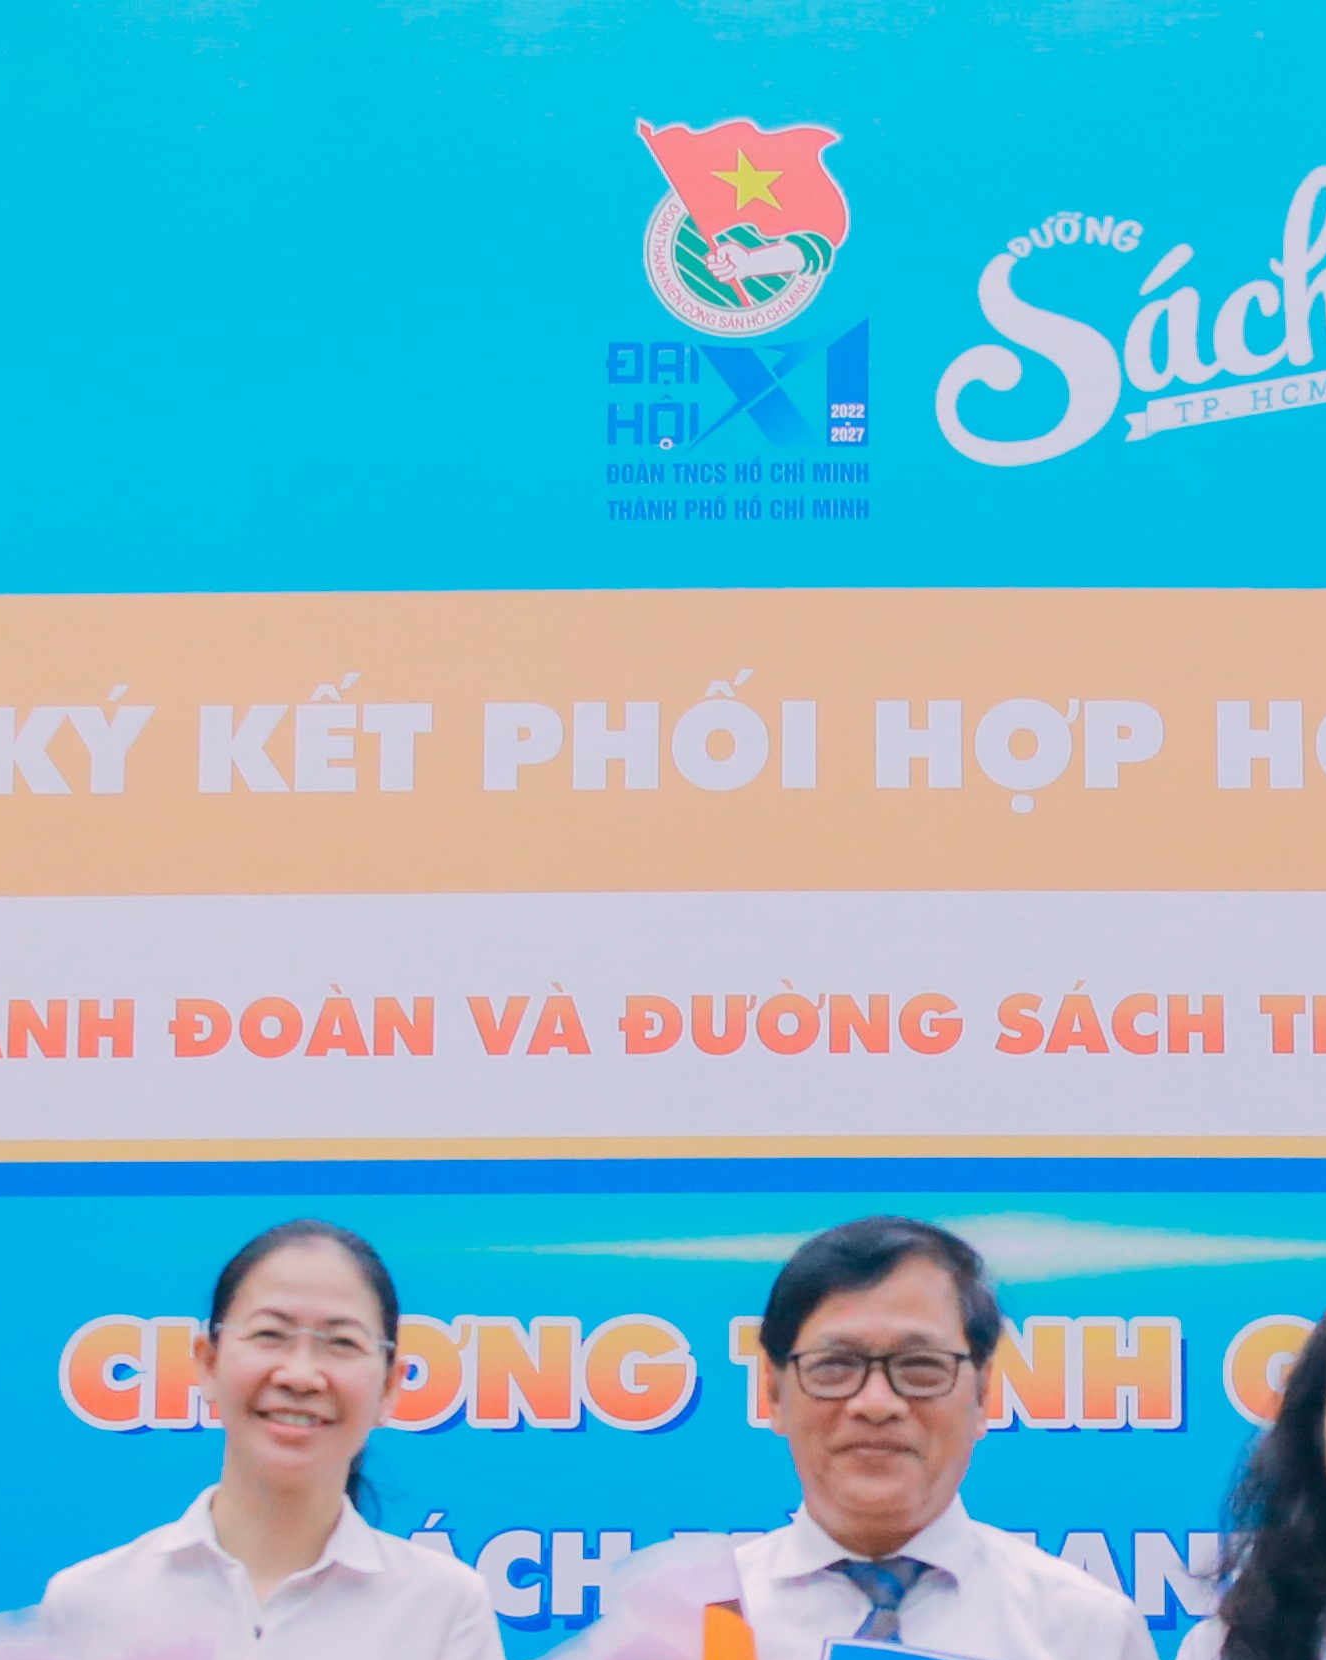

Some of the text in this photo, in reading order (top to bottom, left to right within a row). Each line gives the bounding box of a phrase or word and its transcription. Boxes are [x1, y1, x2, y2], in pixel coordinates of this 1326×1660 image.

[606, 342, 699, 386] ĐẠI
[607, 394, 699, 450] HỘI
[830, 403, 865, 419] 2022
[1175, 397, 1230, 424] TP.
[830, 427, 865, 443] 2027
[606, 455, 870, 484] ĐOÀN TNCS HỒ CHÍ MINH
[607, 492, 870, 521] THÀNH PHỐ HỒ CHÍ MINH
[198, 672, 433, 794] KẾT
[483, 669, 816, 792] PHỐI
[876, 697, 1165, 814] HỢP
[168, 984, 434, 1059] ĐOÀN
[466, 982, 591, 1056] VÀ
[618, 979, 964, 1056] ĐƯỜNG
[994, 980, 1225, 1055] SÁCH
[60, 1313, 697, 1432] CHƠNG
